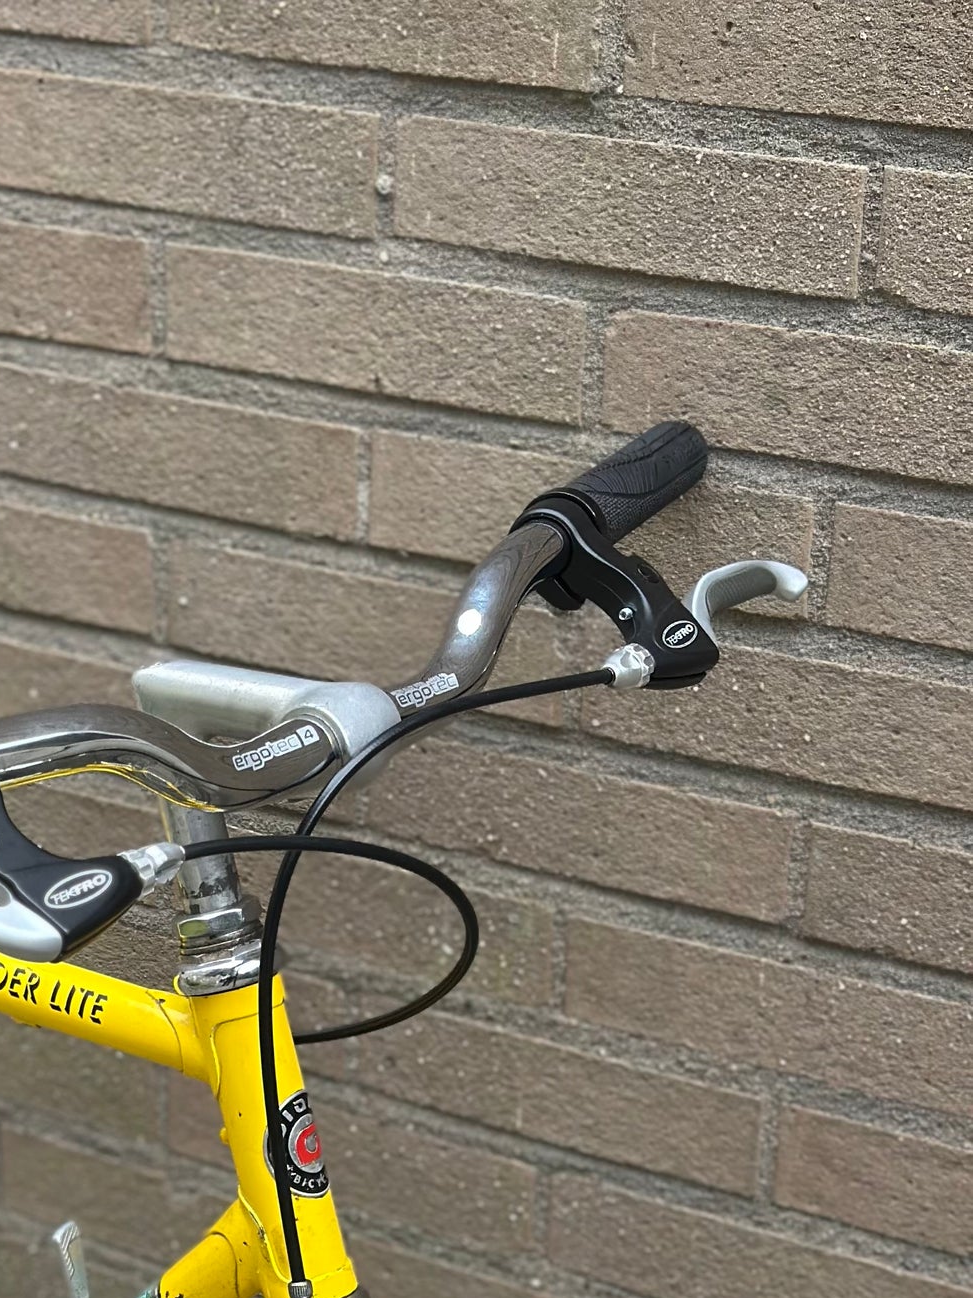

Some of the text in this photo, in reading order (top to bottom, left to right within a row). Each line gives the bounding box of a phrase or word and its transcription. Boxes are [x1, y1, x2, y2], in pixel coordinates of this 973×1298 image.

[397, 675, 458, 707] ergotec
[233, 727, 315, 770] ergotec 4
[49, 979, 109, 1025] LITE
